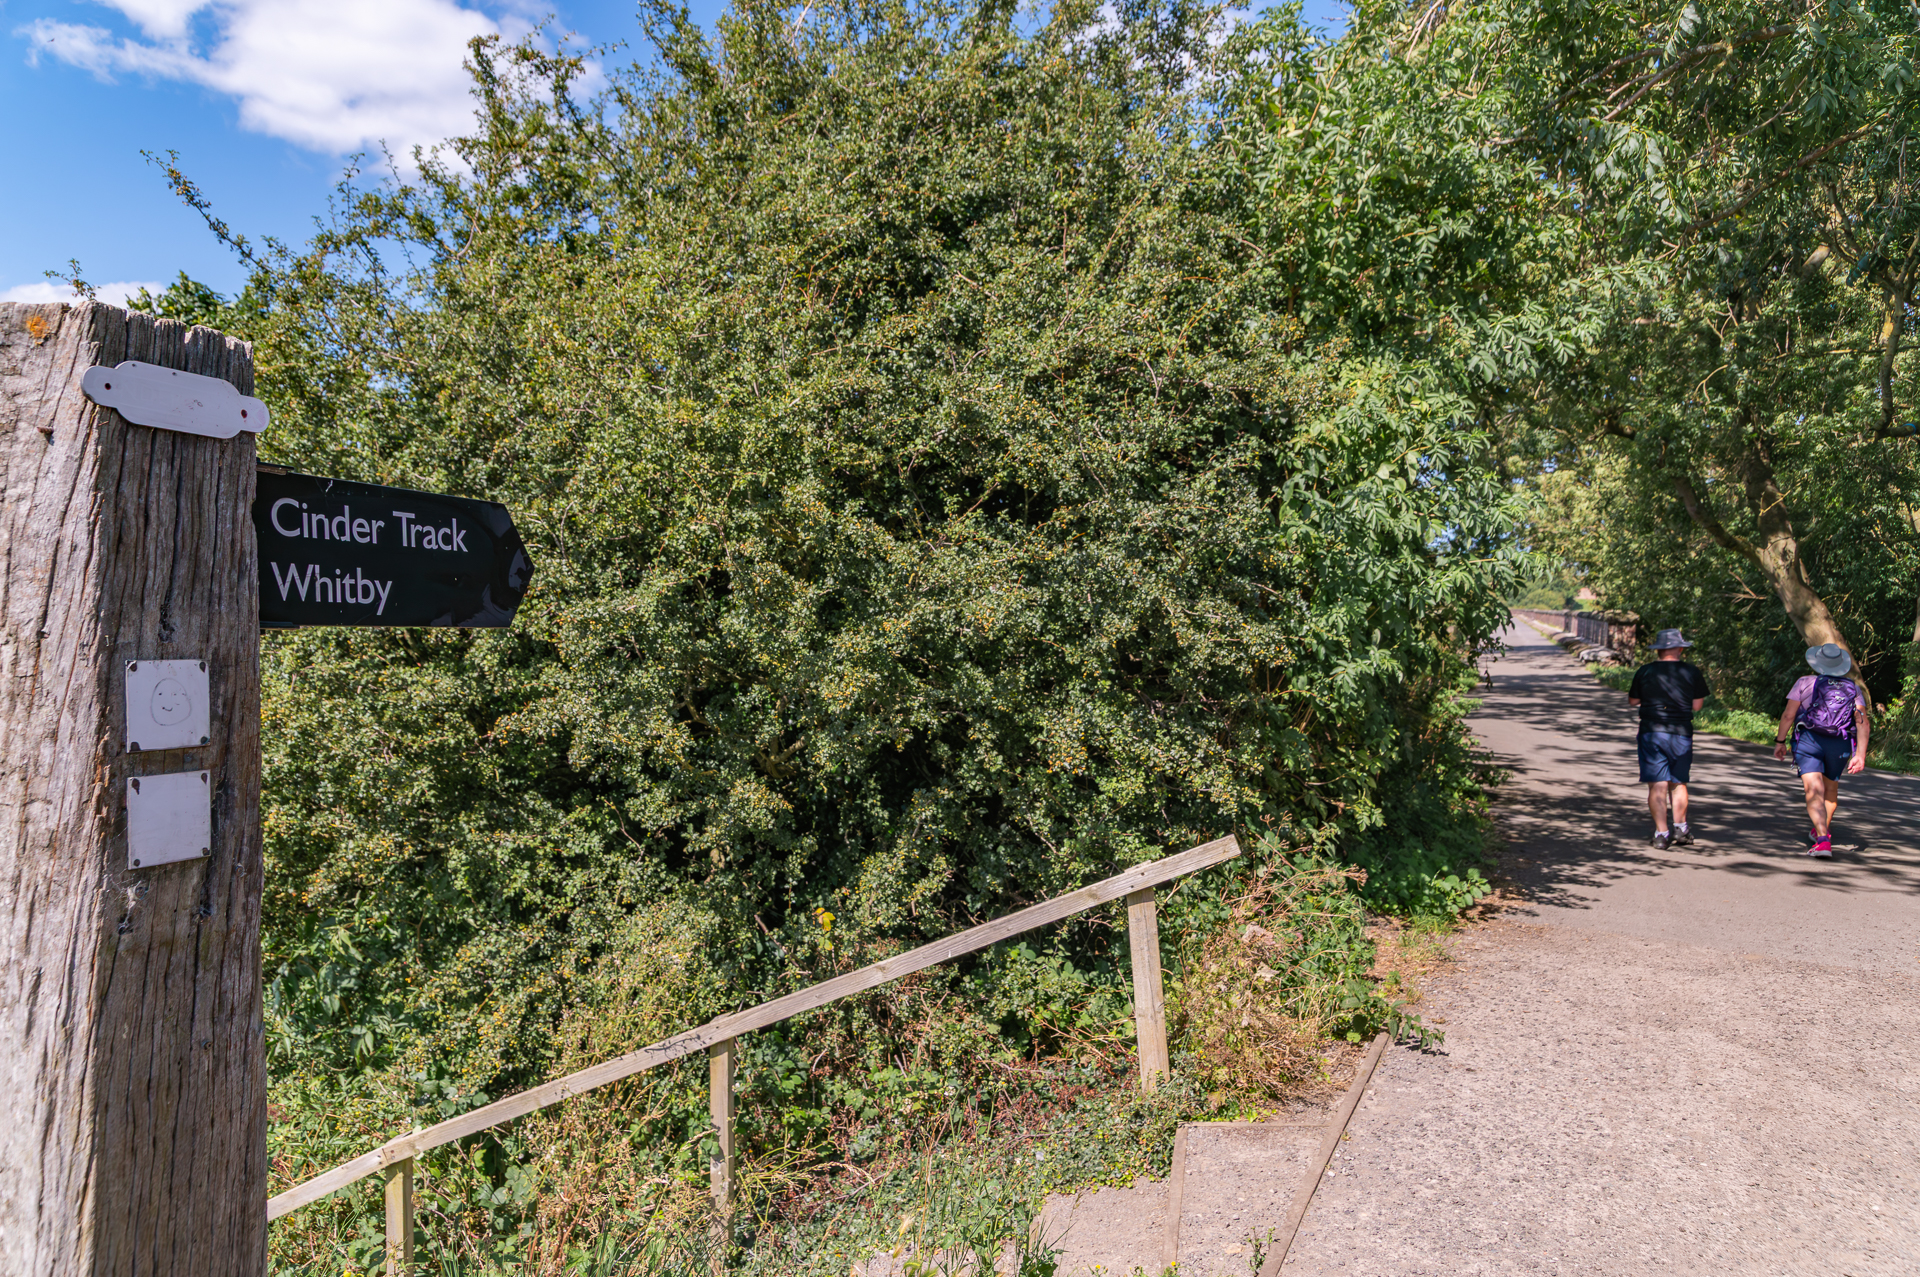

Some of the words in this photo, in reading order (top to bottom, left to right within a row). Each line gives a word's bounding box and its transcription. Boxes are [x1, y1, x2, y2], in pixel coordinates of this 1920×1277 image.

[271, 497, 385, 544] Cinder
[392, 511, 469, 552] Track
[270, 561, 392, 615] Whitby
